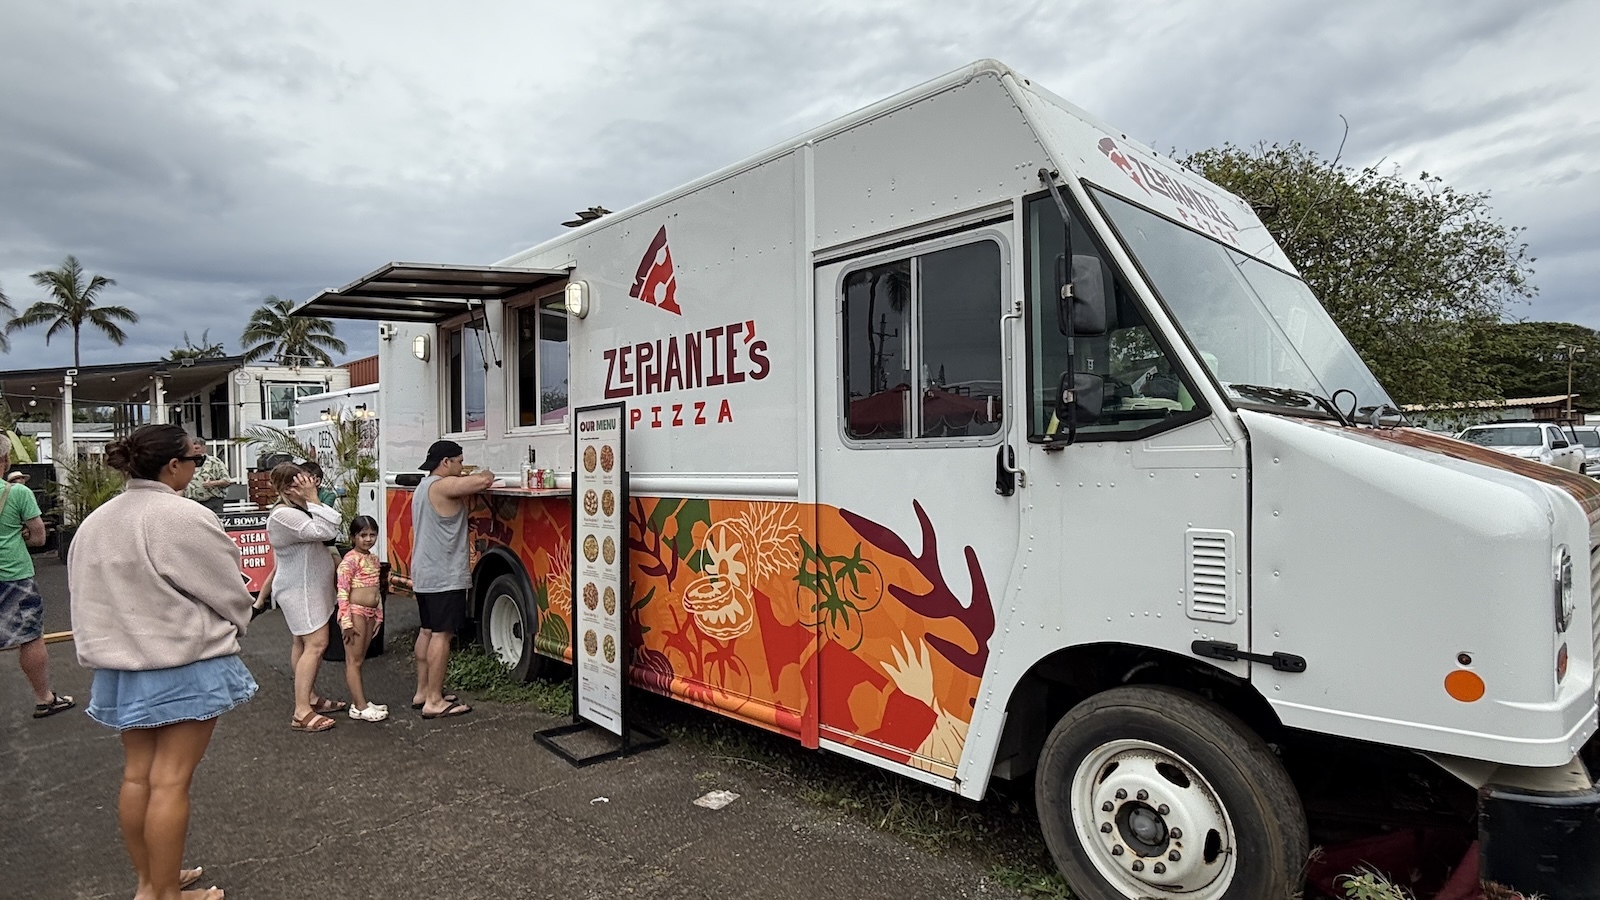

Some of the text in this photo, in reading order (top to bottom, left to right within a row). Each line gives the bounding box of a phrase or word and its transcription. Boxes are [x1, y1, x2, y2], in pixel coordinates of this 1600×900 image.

[630, 399, 733, 430] PIZZA
[580, 418, 617, 433] OUR MENU
[233, 516, 267, 526] BOWLS
[240, 532, 267, 544] STEAK
[243, 557, 266, 568] PORK
